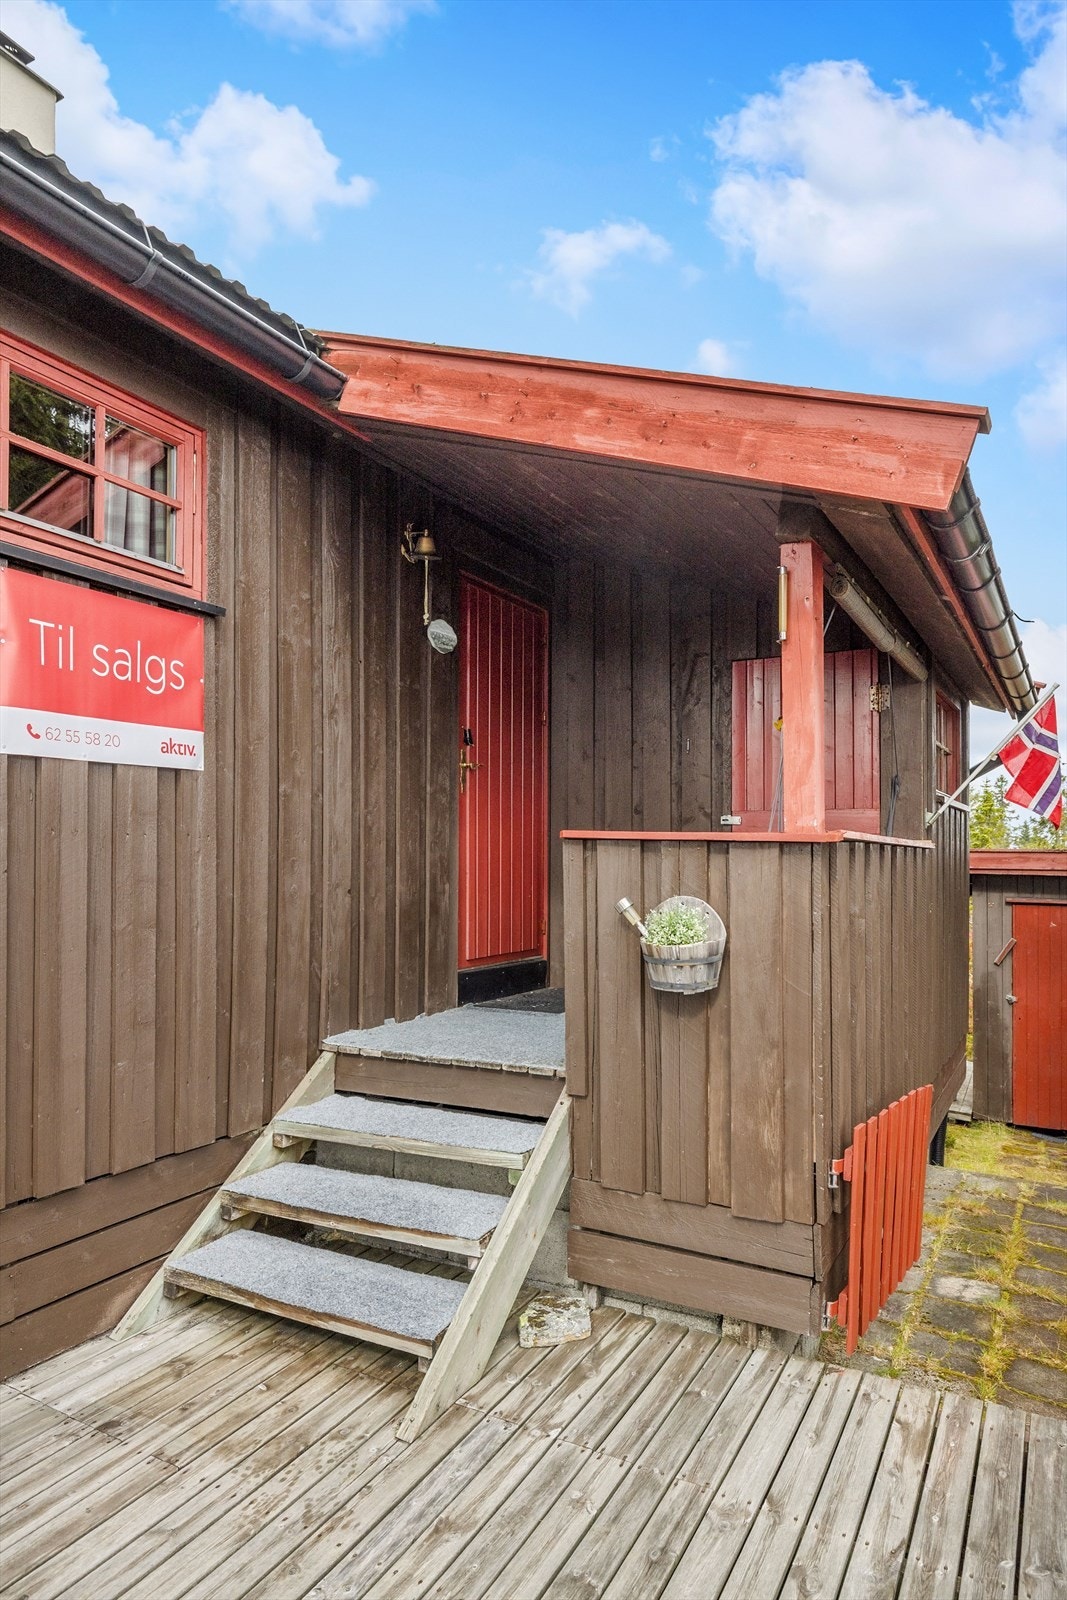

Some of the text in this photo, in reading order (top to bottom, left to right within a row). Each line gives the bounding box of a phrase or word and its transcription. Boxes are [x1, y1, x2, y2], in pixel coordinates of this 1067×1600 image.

[28, 618, 185, 695] Til salgs
[45, 726, 121, 748] 62 55 58 20
